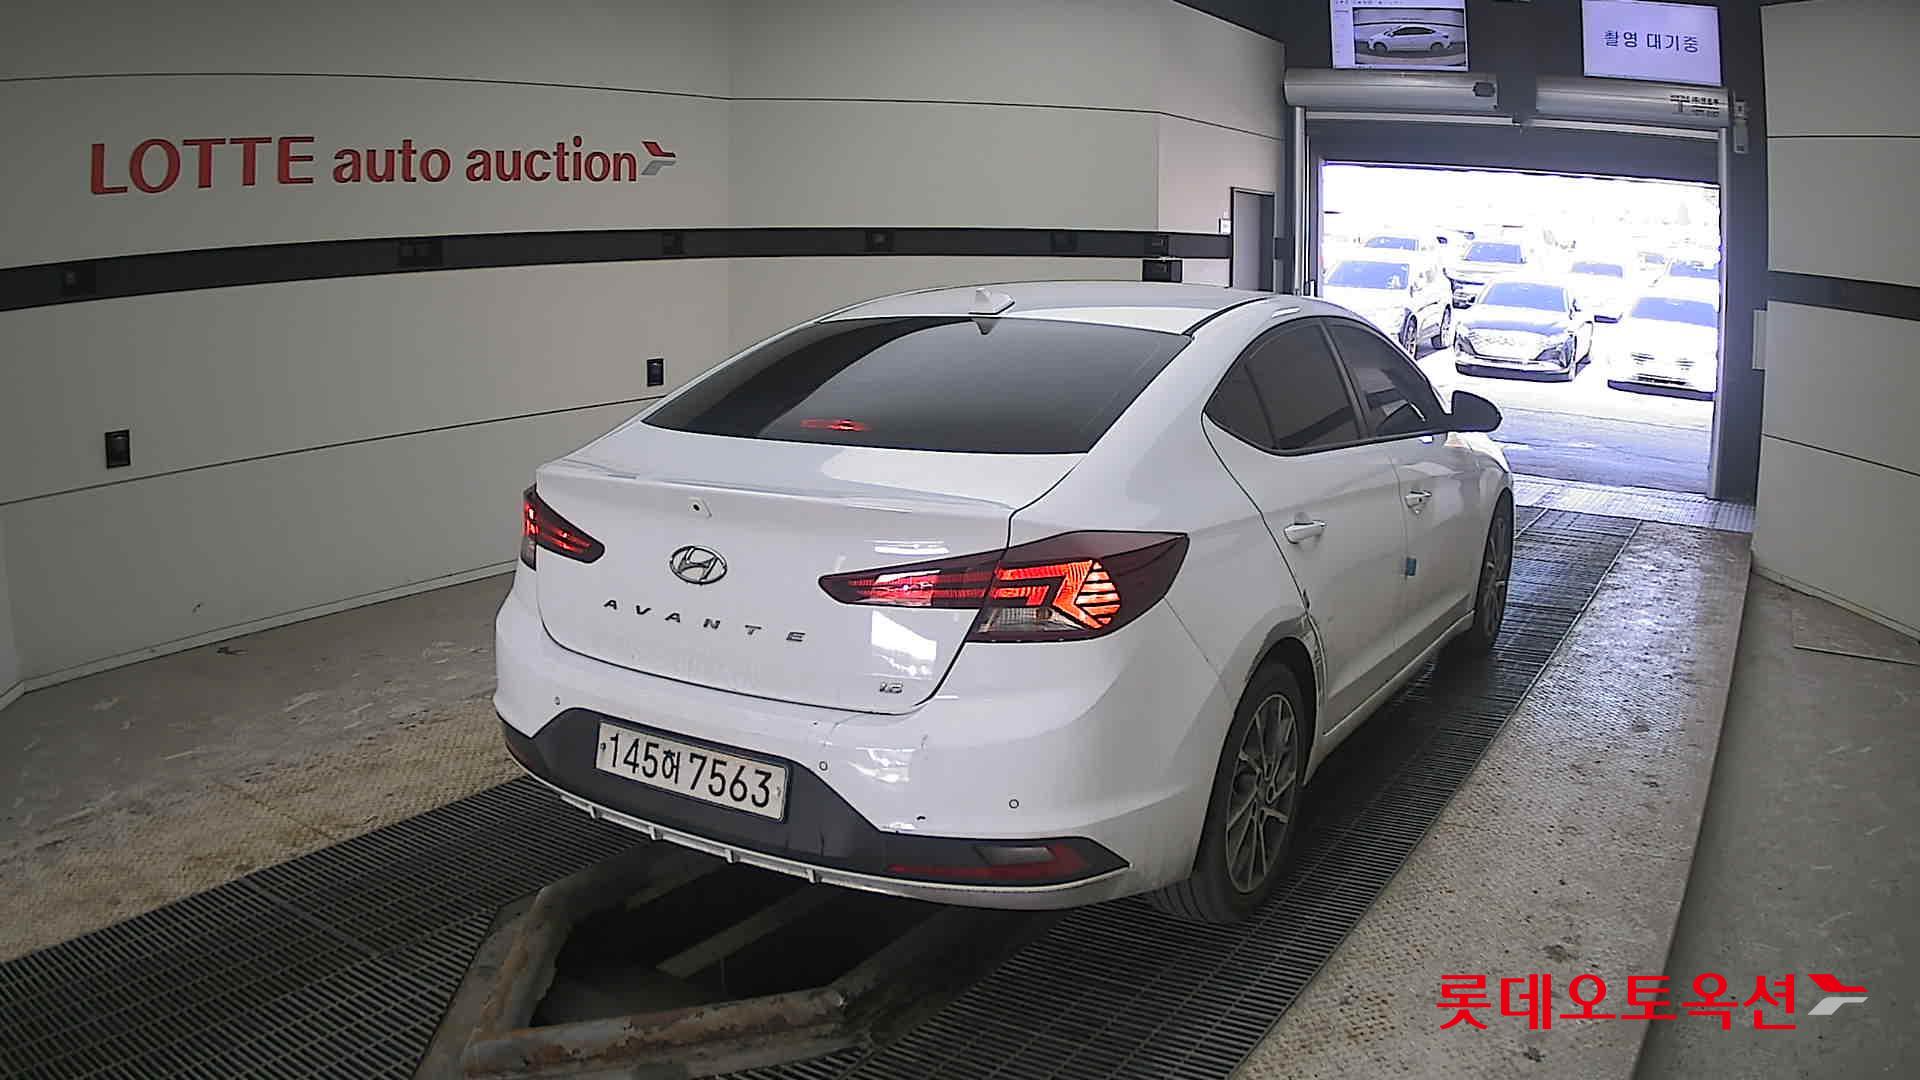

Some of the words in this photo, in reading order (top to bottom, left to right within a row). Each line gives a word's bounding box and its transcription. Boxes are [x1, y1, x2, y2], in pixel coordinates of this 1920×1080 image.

[1646, 33, 1699, 53] 대기중
[91, 137, 315, 195] LOTTE
[332, 139, 451, 183] auto
[465, 136, 638, 182] auction
[604, 599, 806, 643] AVANTE
[689, 752, 772, 808] 7563
